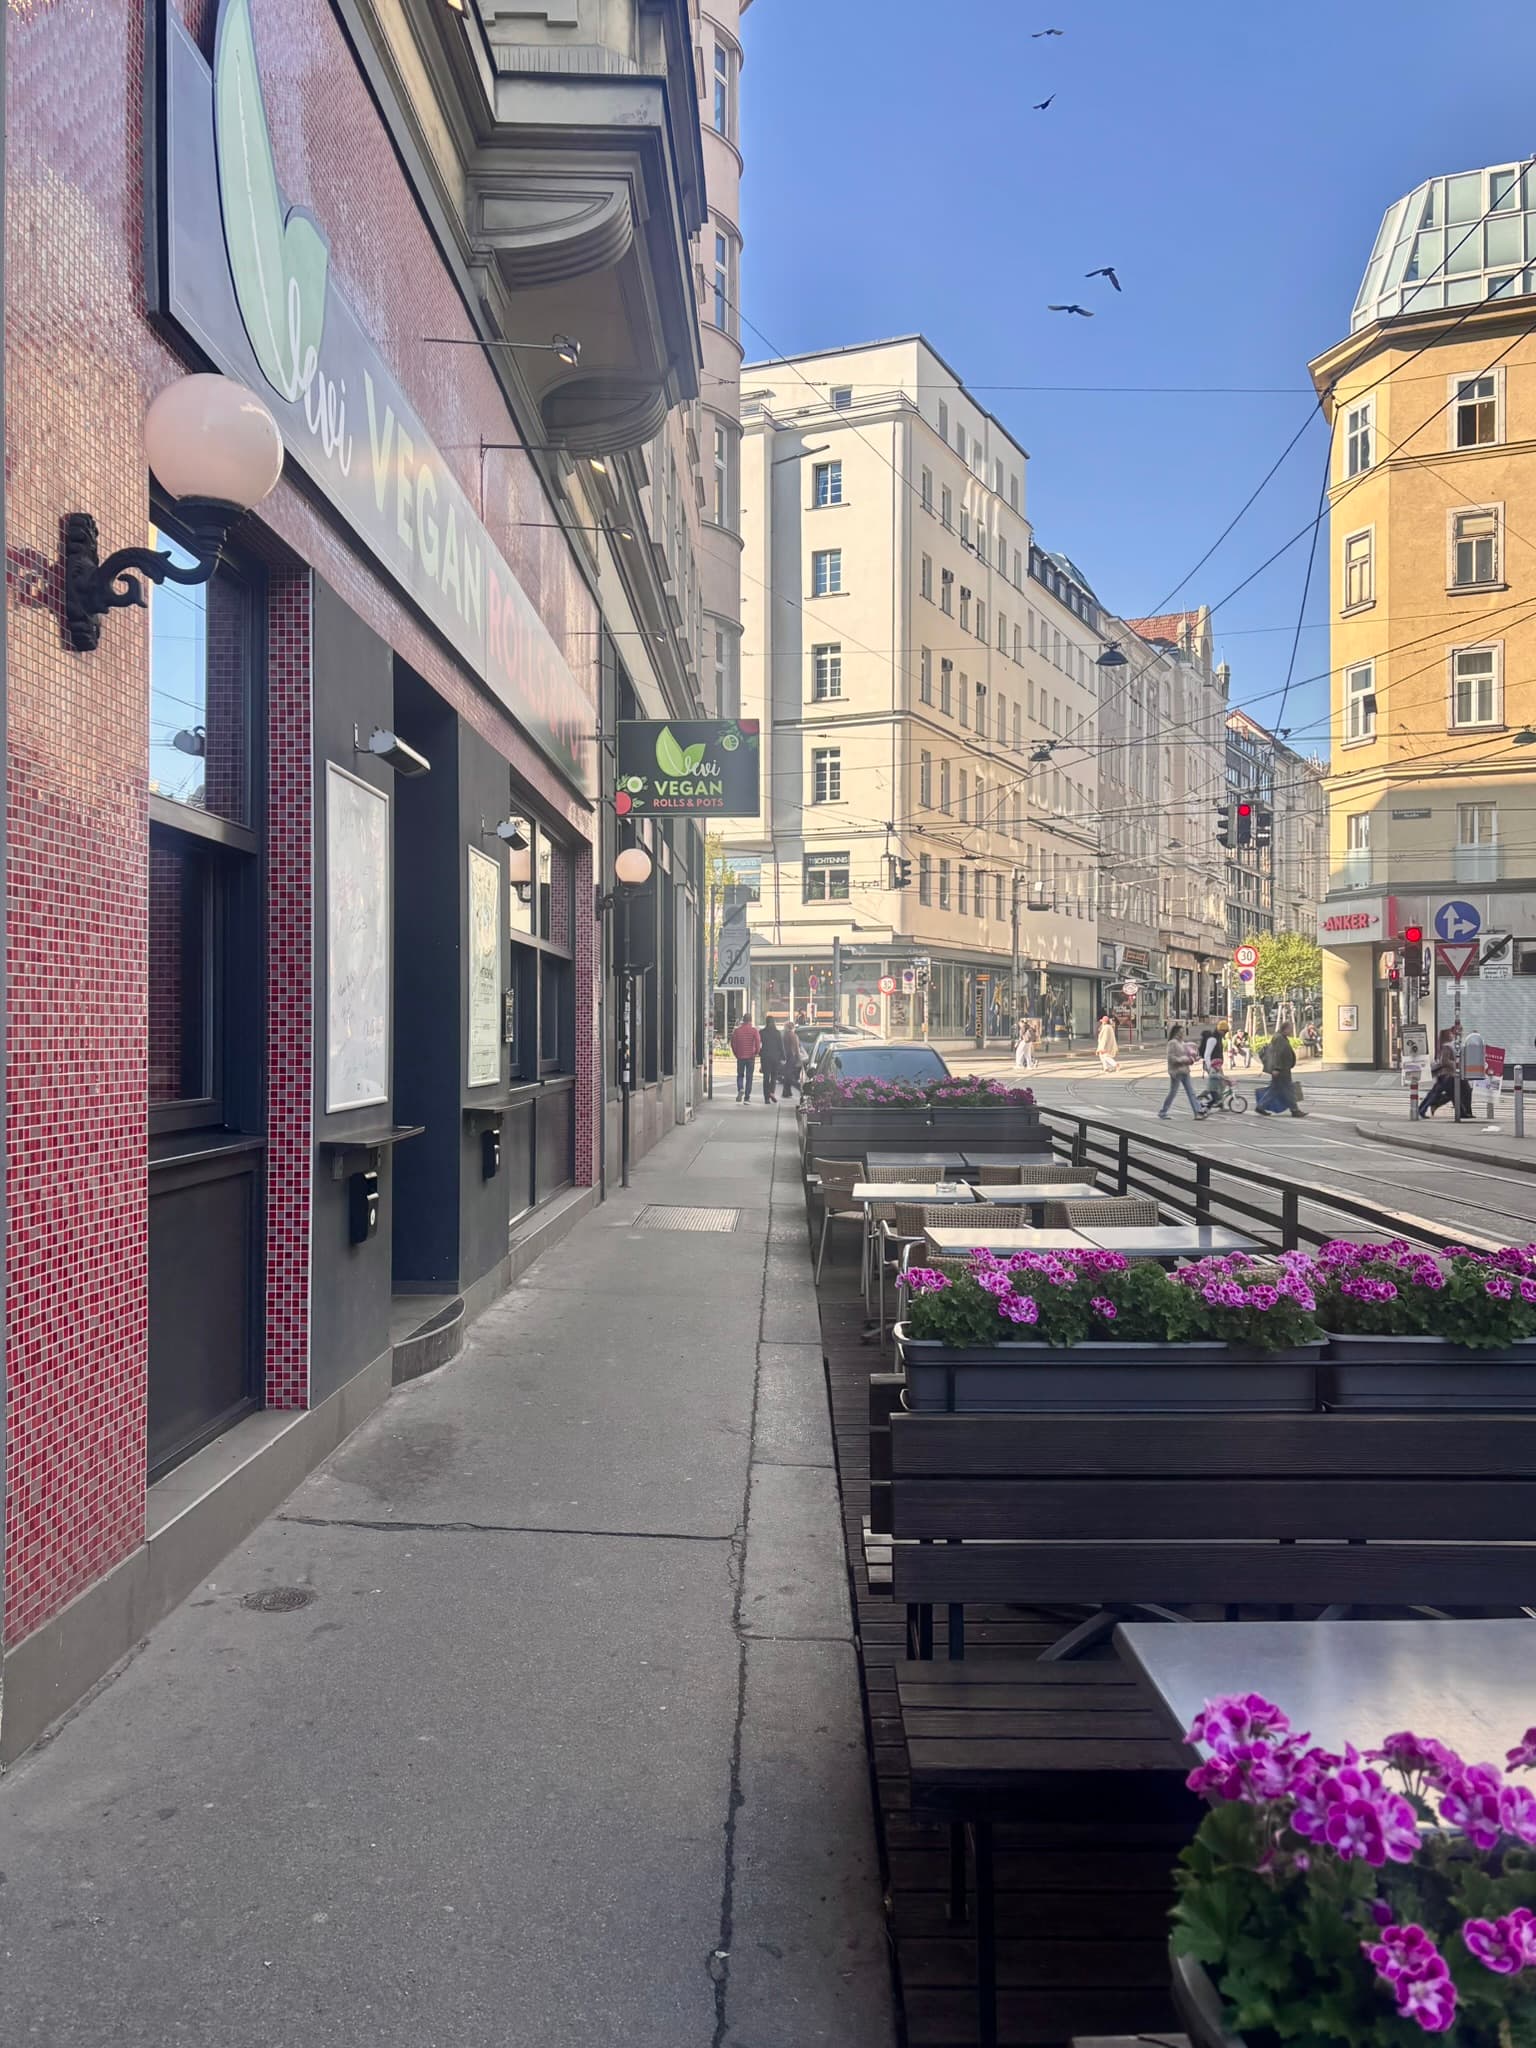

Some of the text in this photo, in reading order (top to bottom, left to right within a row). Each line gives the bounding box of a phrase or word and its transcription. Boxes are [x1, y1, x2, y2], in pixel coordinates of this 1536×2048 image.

[285, 277, 353, 477] levi
[363, 368, 482, 637] VEGAN
[488, 567, 546, 720] ROLLS
[683, 755, 721, 777] levi
[654, 780, 723, 796] VEGAN
[653, 798, 724, 808] ROLLS & POTS
[1325, 912, 1370, 931] ANKER
[1240, 950, 1253, 961] 30
